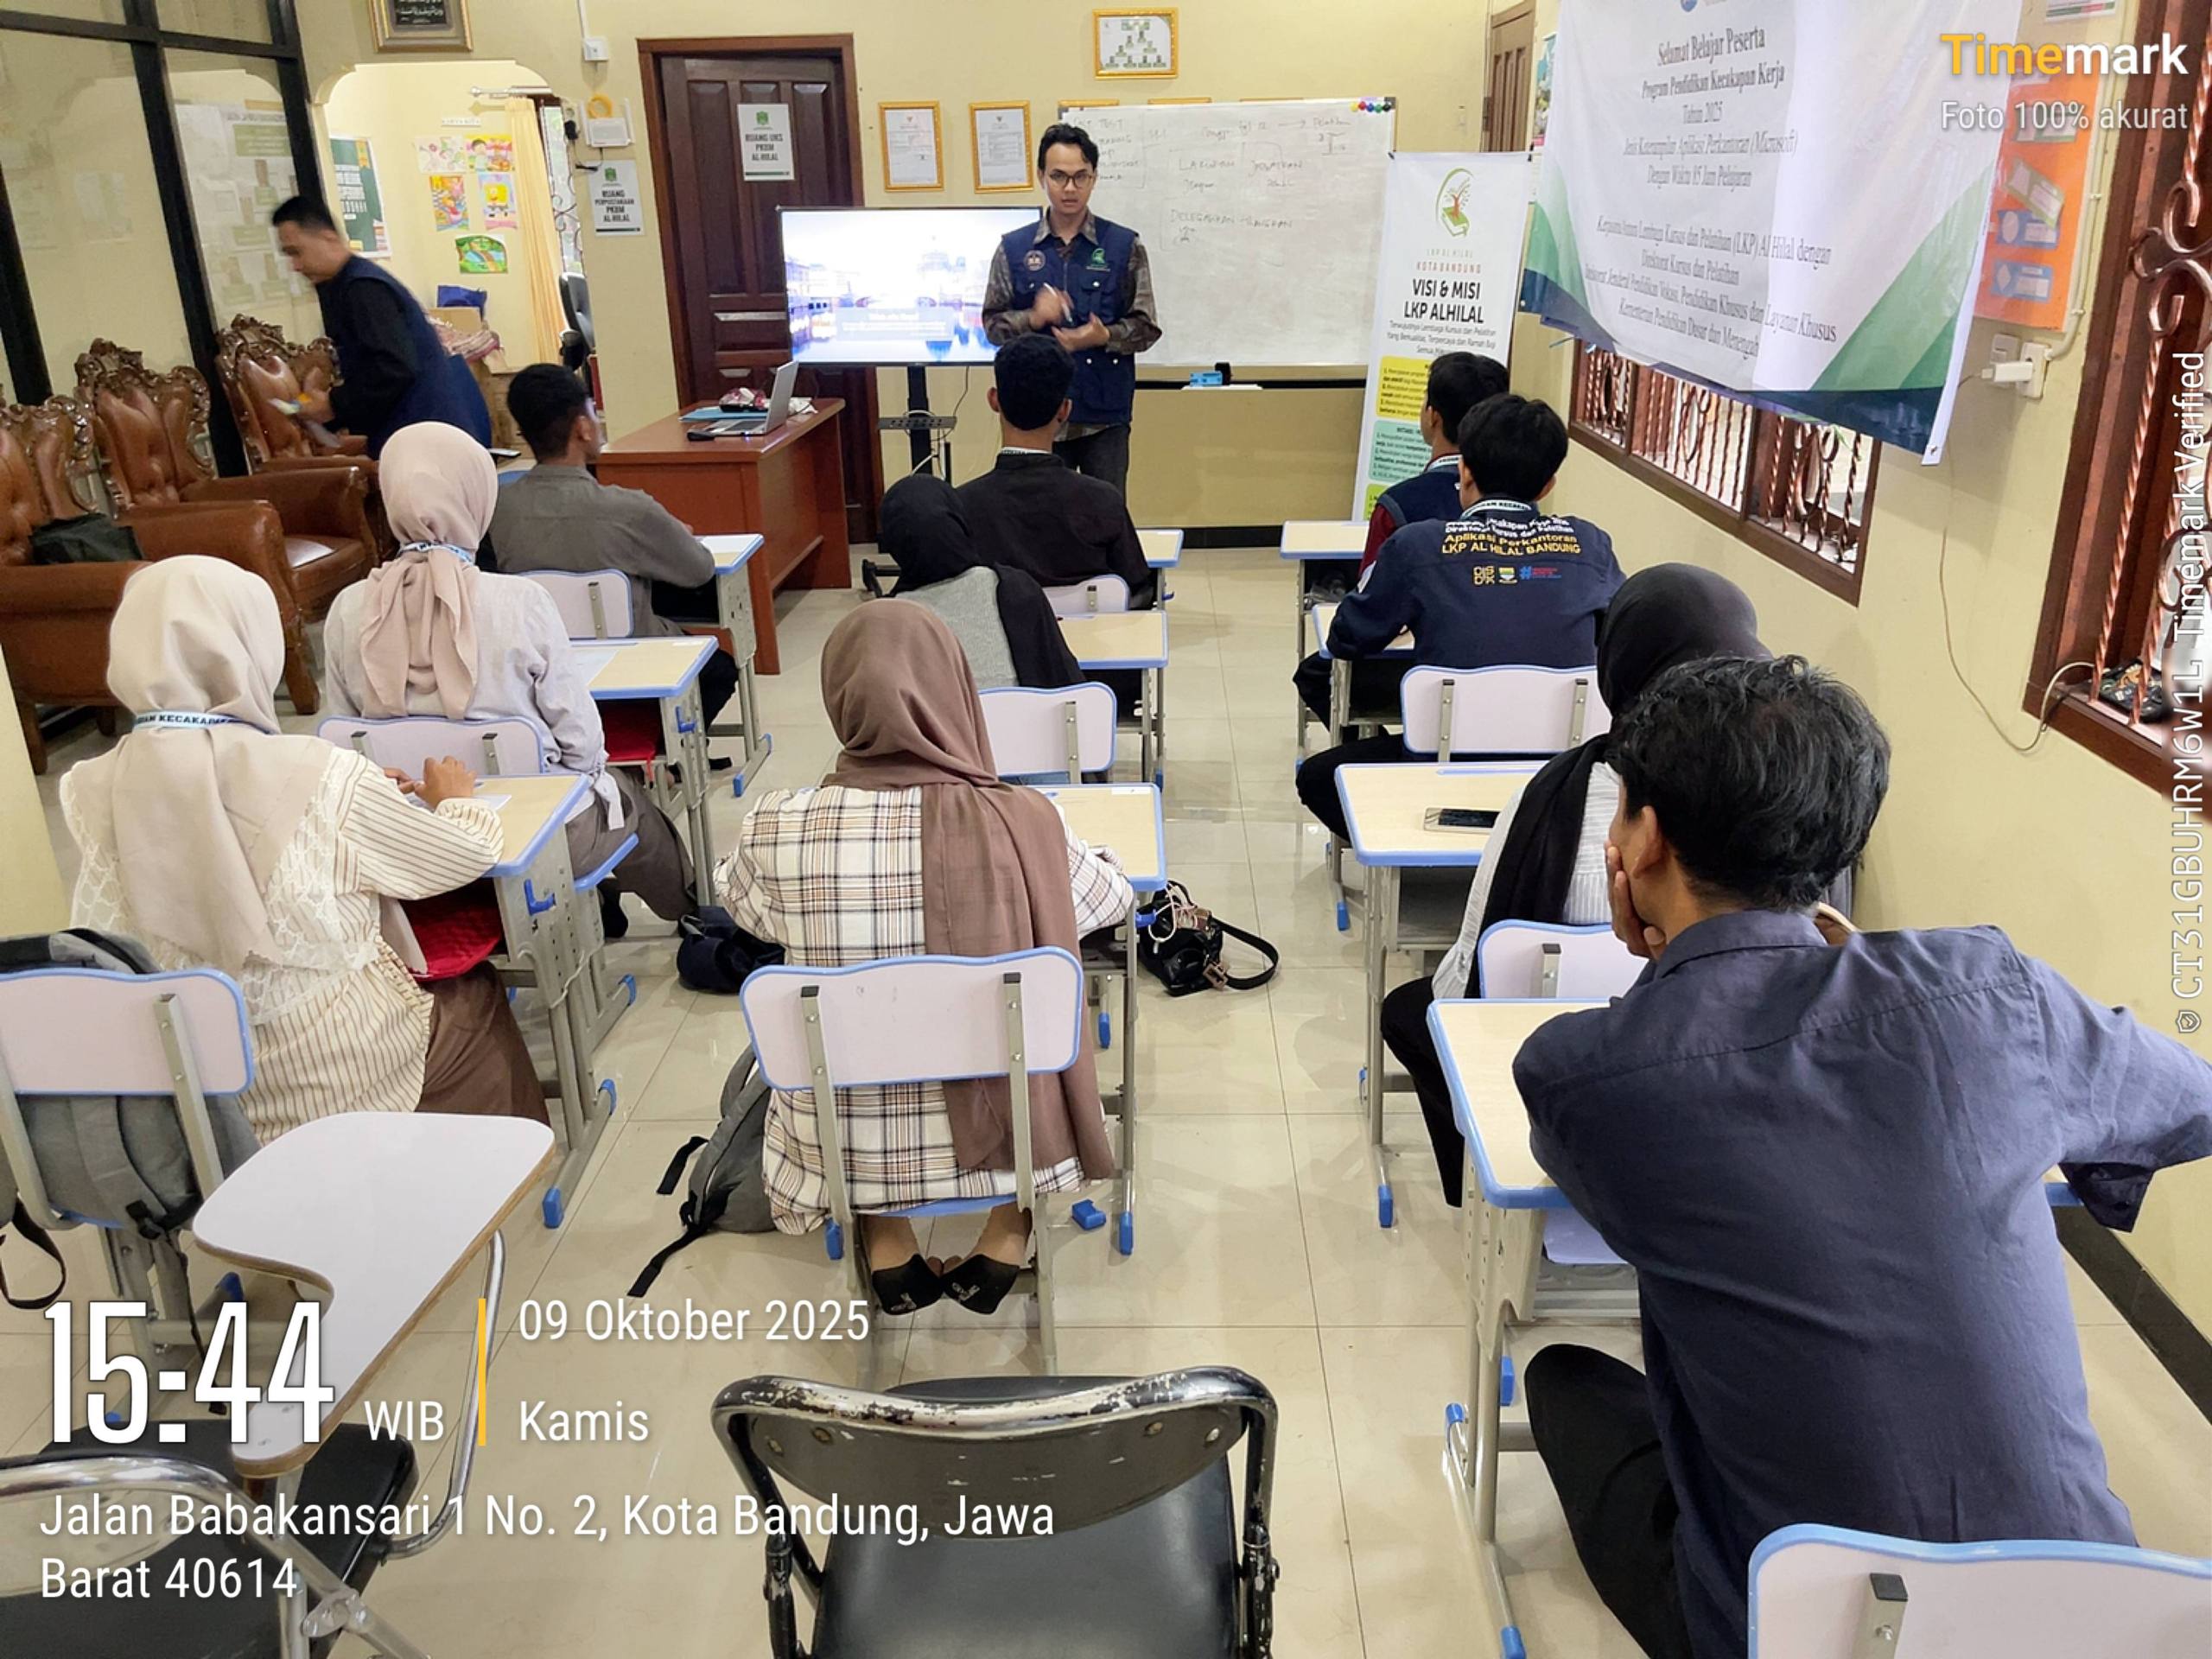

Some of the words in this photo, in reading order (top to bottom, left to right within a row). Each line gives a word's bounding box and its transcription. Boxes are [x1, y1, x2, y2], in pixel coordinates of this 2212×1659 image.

[1691, 31, 1724, 65] Belajar
[1726, 26, 1766, 55] Peserta
[1758, 59, 1786, 89] Kerja
[1732, 231, 1758, 261] (LKP)
[1770, 234, 1795, 260] Hilal
[1796, 237, 1832, 270] dengan
[1416, 261, 1437, 272] KOTA
[1440, 263, 1481, 274] BANDUNG
[1413, 277, 1437, 297] VISI
[1440, 280, 1449, 297] &
[1452, 281, 1481, 300] MISI
[1403, 300, 1428, 319] LKP
[1430, 302, 1484, 324] ALHILAL
[1719, 294, 1749, 321] Khusus
[1749, 300, 1765, 325] dan
[1764, 303, 1799, 334] Layanan
[1798, 311, 1838, 343] Khusus
[1442, 543, 1467, 554] LKP
[1471, 542, 1487, 552] AL
[1489, 543, 1524, 556] HILAL
[1526, 542, 1582, 555] BANDUNG
[1444, 532, 1497, 543] Aplikasi
[1499, 533, 1578, 547] Perkantoran
